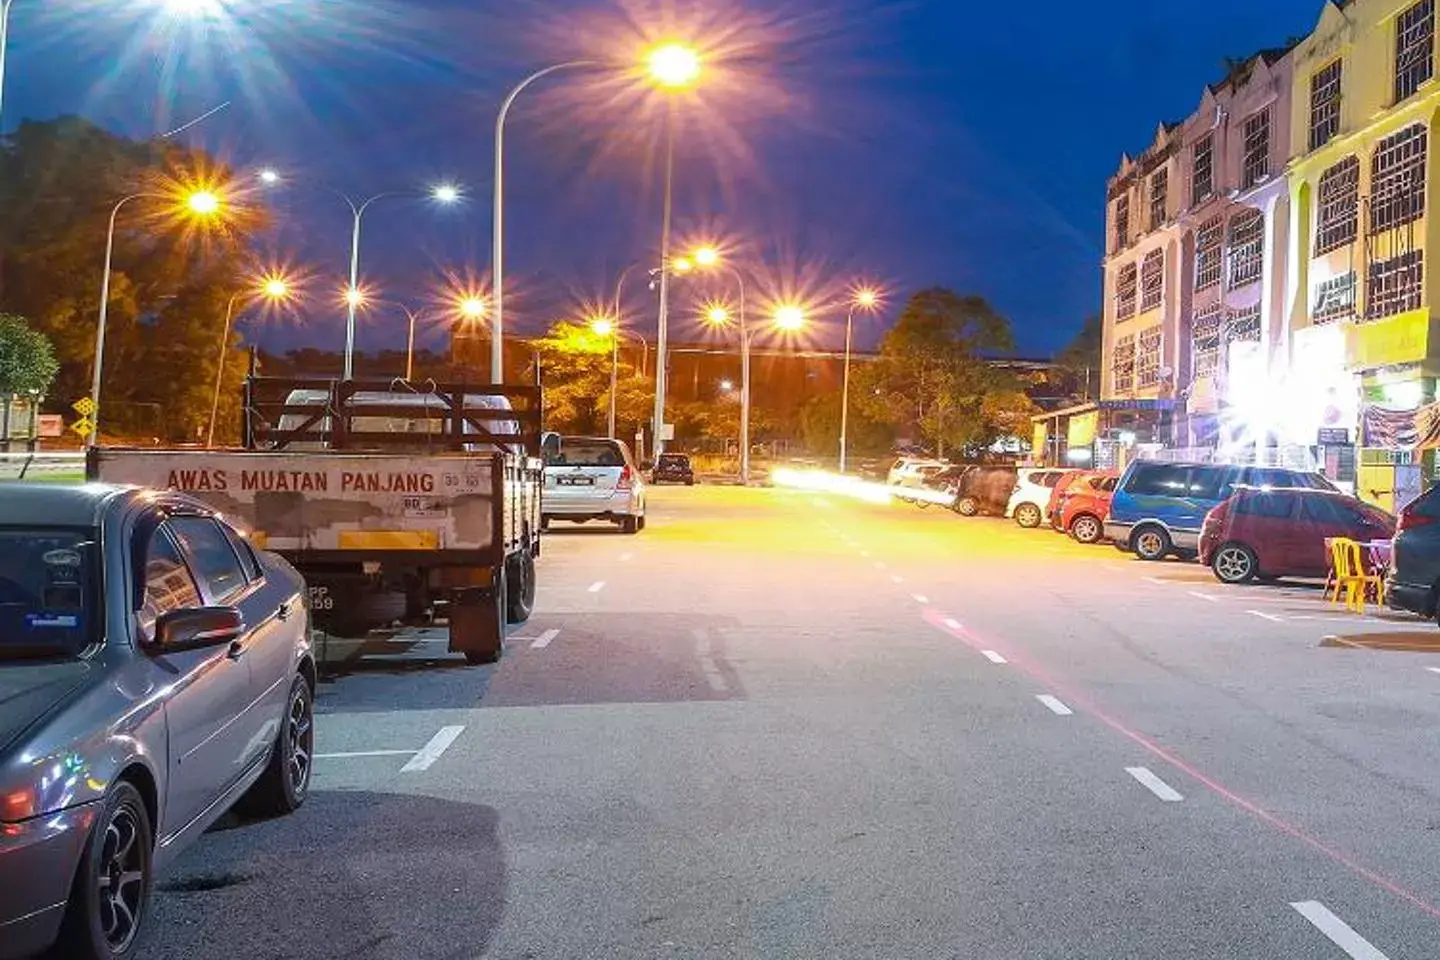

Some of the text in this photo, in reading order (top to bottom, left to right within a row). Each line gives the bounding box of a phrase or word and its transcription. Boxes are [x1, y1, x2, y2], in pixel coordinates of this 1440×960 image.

[167, 470, 227, 490] AWAS
[241, 471, 327, 491] MUATAN
[341, 472, 434, 492] PANJANG
